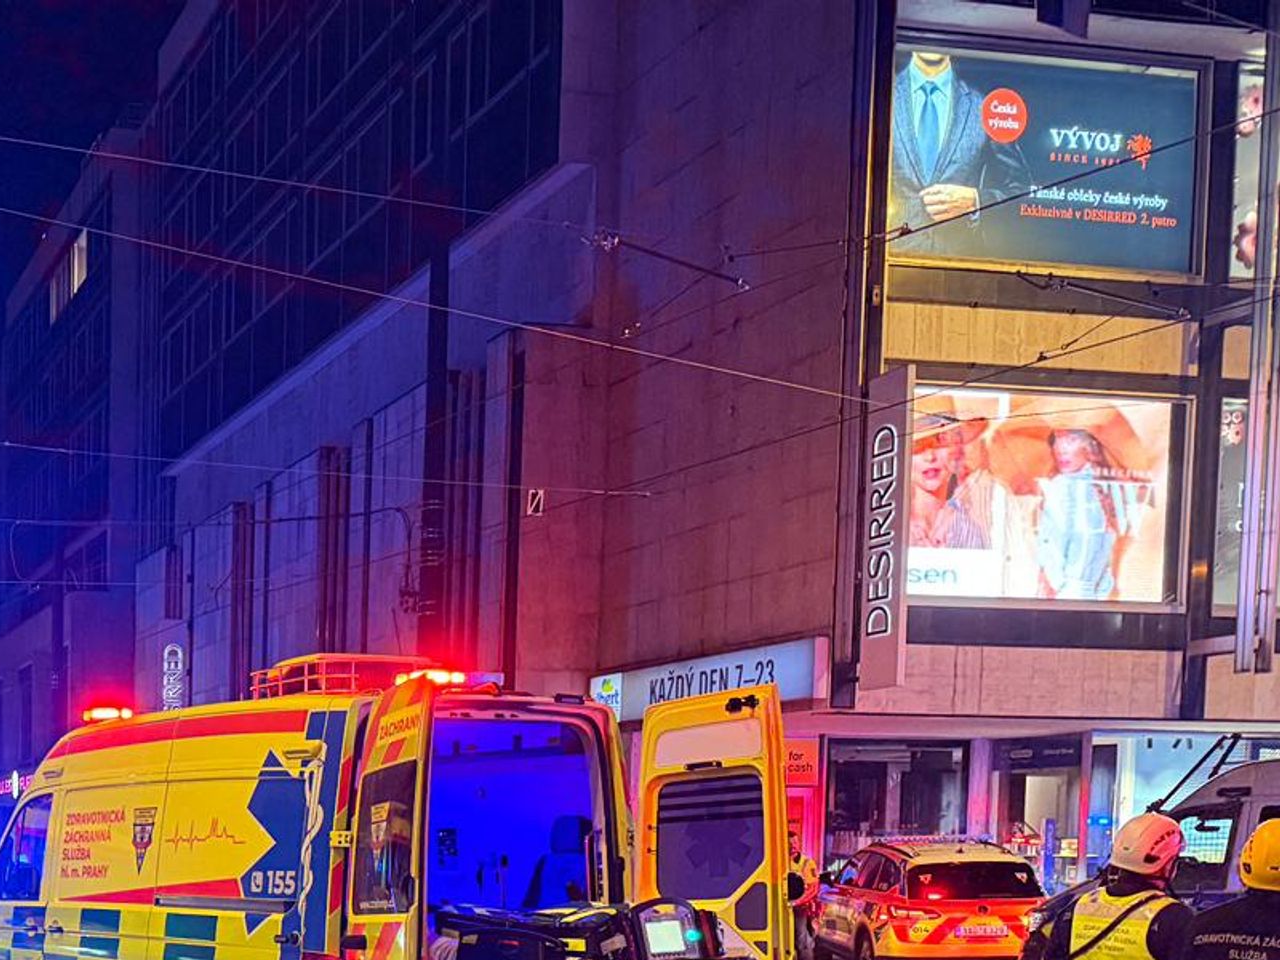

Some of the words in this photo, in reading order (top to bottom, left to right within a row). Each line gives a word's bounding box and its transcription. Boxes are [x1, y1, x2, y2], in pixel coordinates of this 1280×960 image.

[1049, 126, 1122, 152] VÝVOJ
[865, 423, 898, 638] DESIRRED
[649, 666, 695, 704] KAŽDÝ
[788, 751, 804, 761] for
[788, 763, 813, 772] cash
[267, 870, 296, 895] 155
